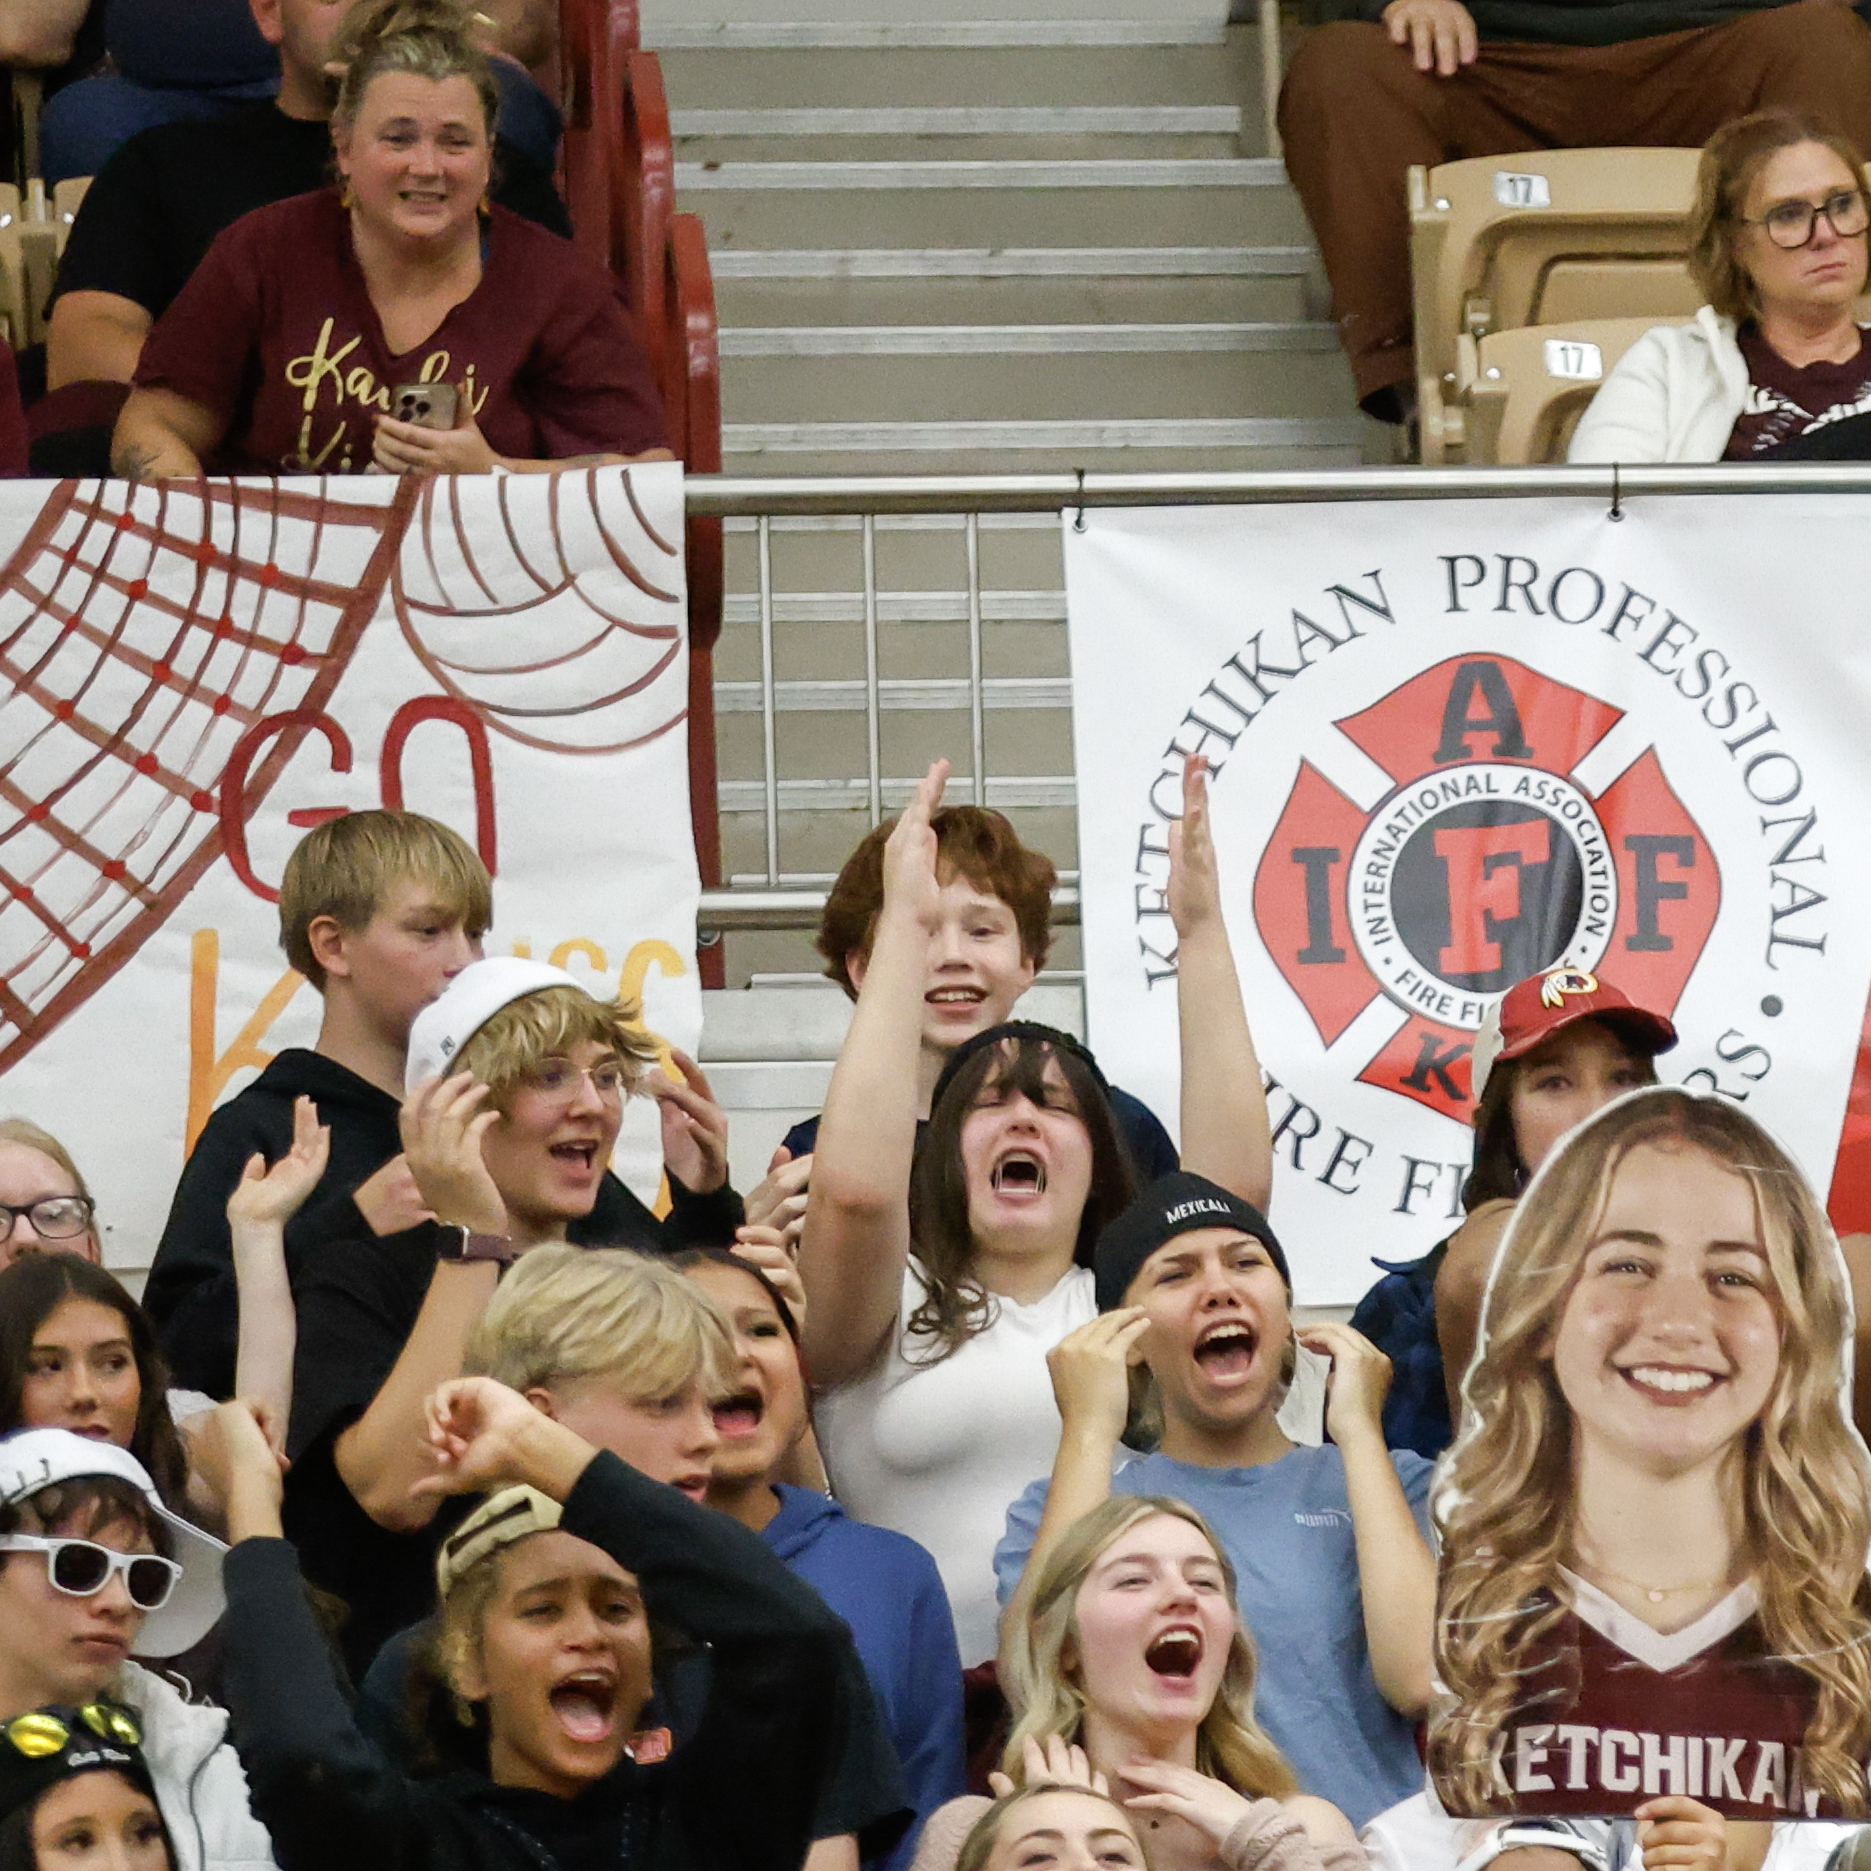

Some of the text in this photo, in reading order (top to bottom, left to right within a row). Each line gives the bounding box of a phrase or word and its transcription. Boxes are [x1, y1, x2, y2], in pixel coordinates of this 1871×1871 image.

[1507, 176, 1533, 204] 17
[1559, 346, 1584, 374] 17
[1432, 660, 1535, 764] A
[1438, 553, 1829, 972] PROFESSIONAL
[1363, 772, 1610, 947] INTERNATIONAL ASSOCIATION
[1433, 818, 1551, 974] F
[1624, 834, 1695, 952] F
[1393, 967, 1456, 1017] FIRE
